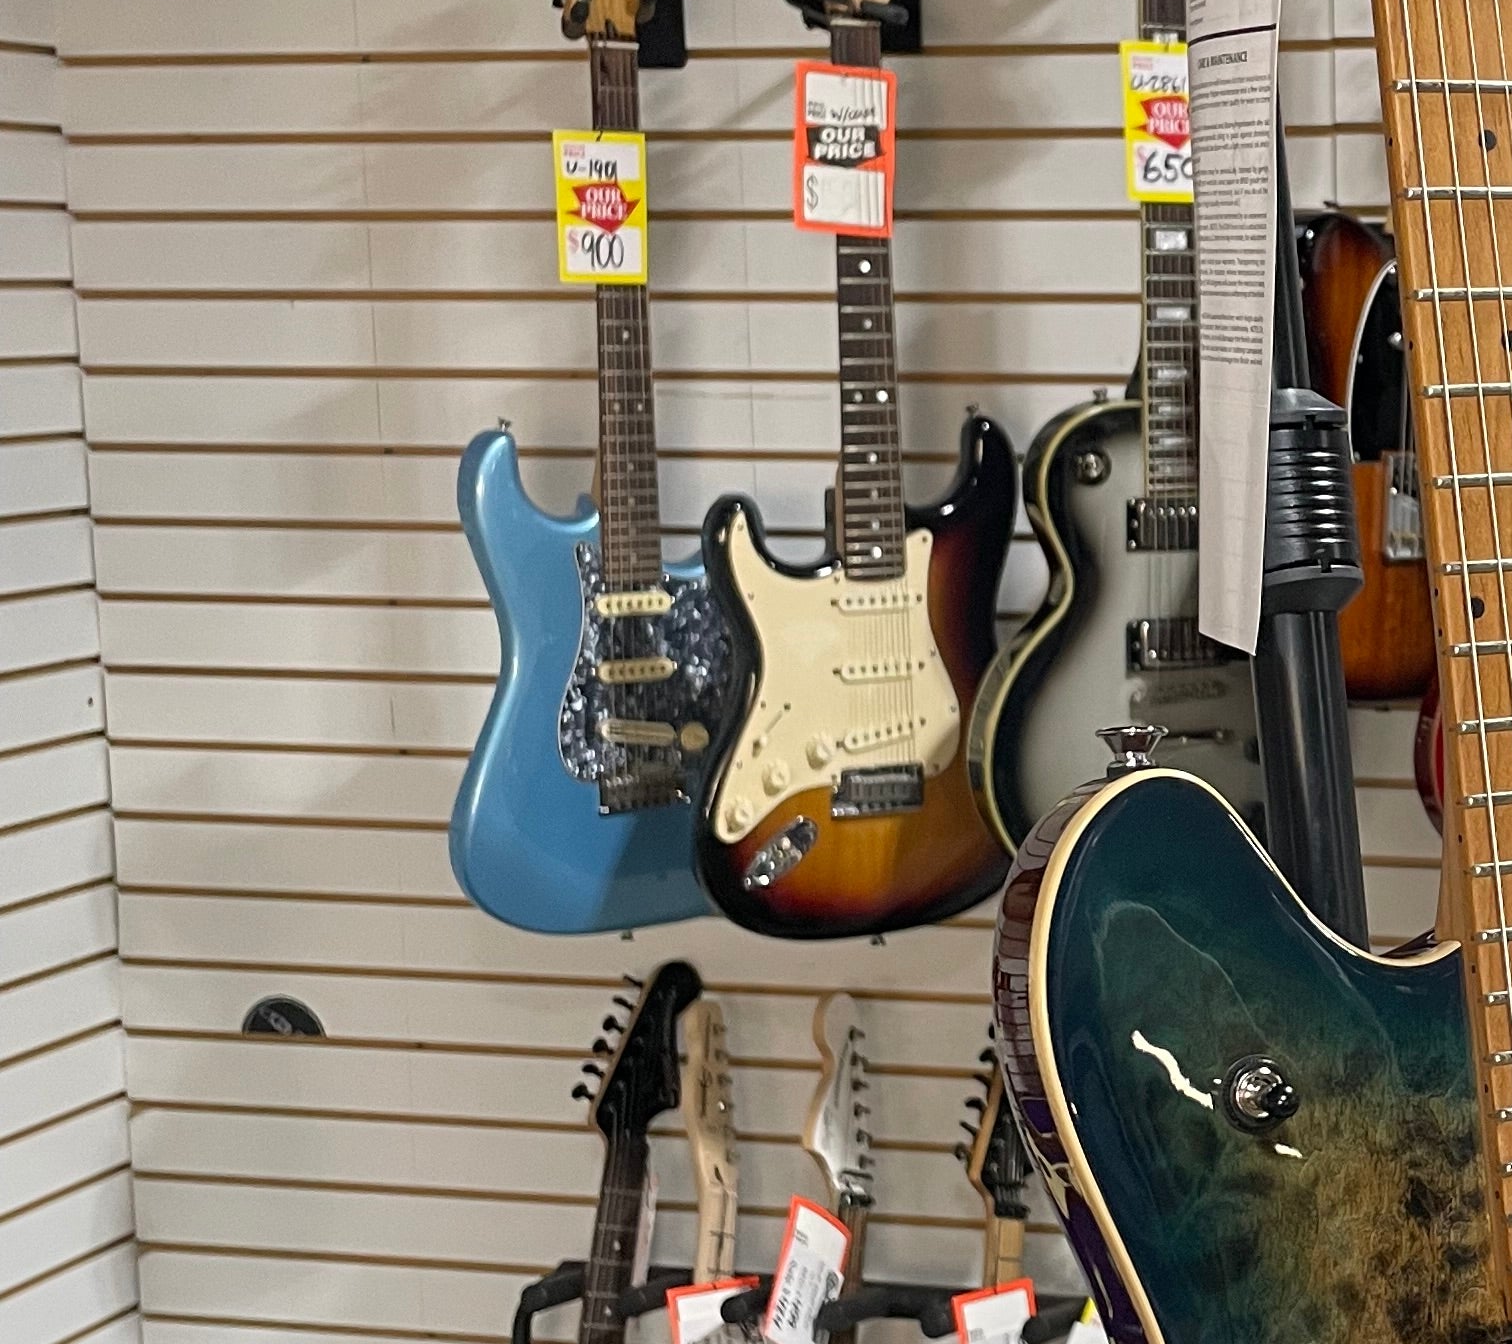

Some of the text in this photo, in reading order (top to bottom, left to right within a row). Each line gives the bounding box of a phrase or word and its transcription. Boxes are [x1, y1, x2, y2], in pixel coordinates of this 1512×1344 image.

[820, 127, 866, 144] OUR
[814, 141, 876, 160] PRICE
[585, 186, 622, 203] OUR
[580, 201, 628, 221] PRICE
